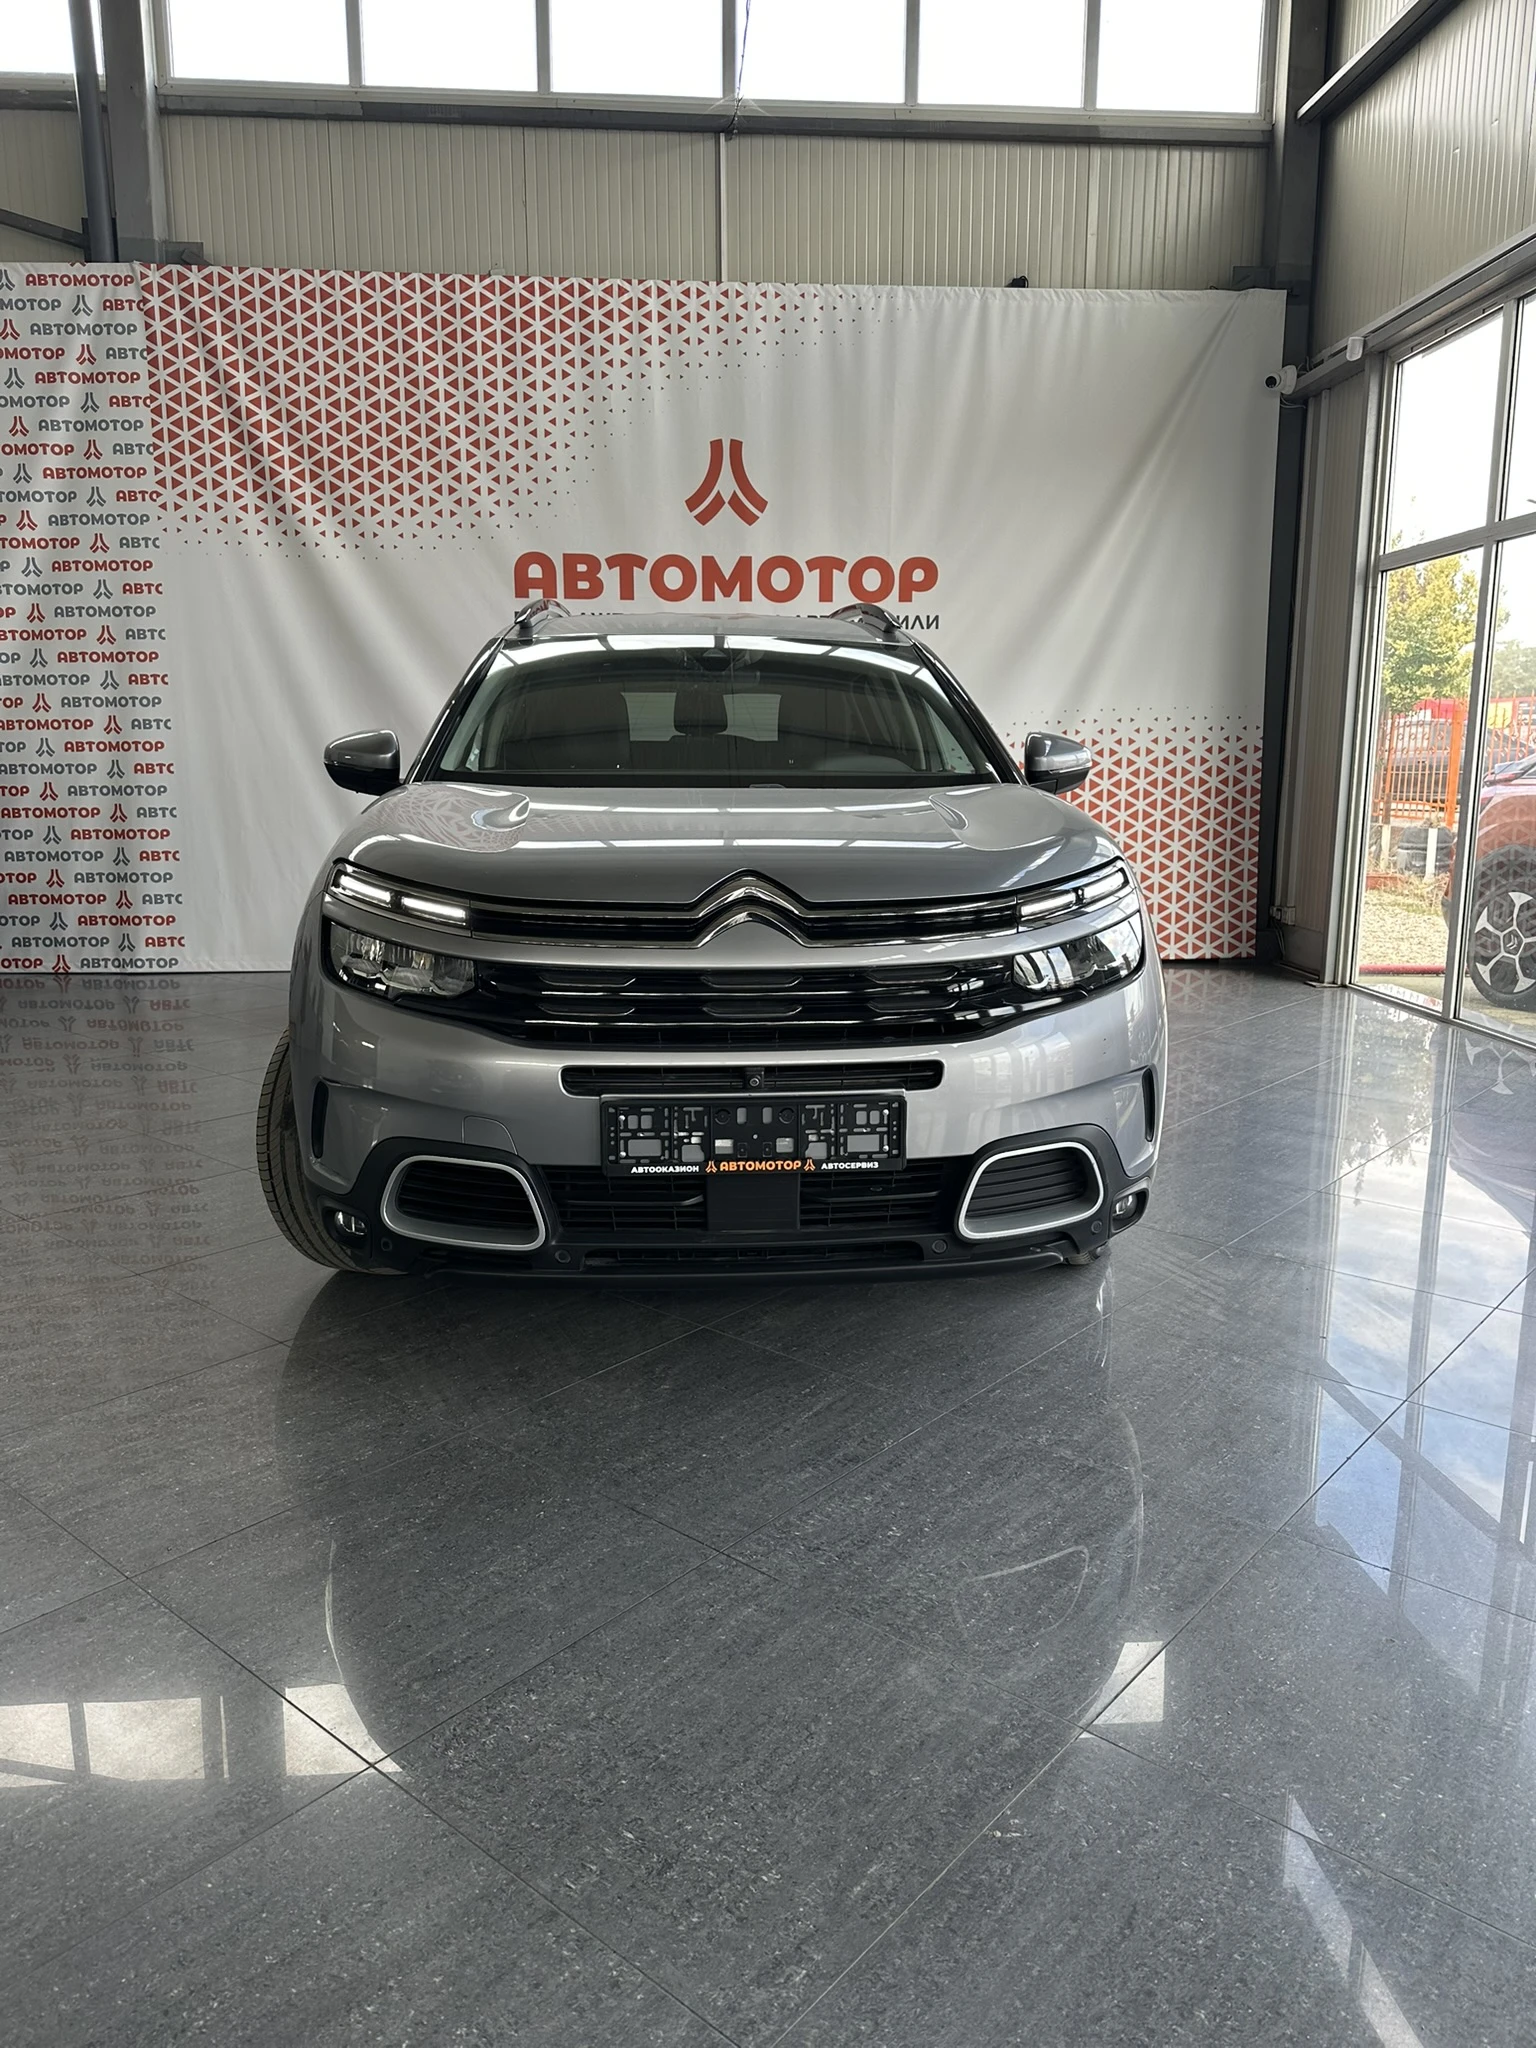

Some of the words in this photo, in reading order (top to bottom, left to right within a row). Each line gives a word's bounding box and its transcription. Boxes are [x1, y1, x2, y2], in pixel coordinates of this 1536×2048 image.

[25, 274, 134, 286] АВТОМОТОР
[30, 323, 138, 335] АВТОМОТОР
[35, 372, 140, 384] АВТОМОТОР
[38, 419, 144, 432] АВТОМОТОР
[43, 467, 147, 479] АВТОМОТОР
[48, 514, 150, 526] АВТОМОТОР
[52, 560, 153, 572] АВТОМОТОР
[513, 551, 939, 603] АВТОМОТОР
[0, 583, 83, 595] ТОМОТОР
[54, 606, 156, 618] АВТОМОТОР
[57, 651, 159, 663] АВТОМОТОР
[0, 674, 90, 686] ВТОМОТОР
[61, 696, 162, 708] АВТОМОТОР
[64, 741, 165, 752] АВТОМОТОР
[0, 763, 97, 774] АВТОМОТОР
[68, 785, 167, 796] АВТОМОТОР
[1, 807, 100, 819] АВТОМОТОР
[71, 829, 170, 840] АВТОМОТОР
[4, 851, 103, 862] АВТОМОТОР
[74, 872, 173, 883] АВТОМОТОР
[8, 894, 107, 905] АВТОМОТОР
[78, 915, 176, 926] АВТОМОТОР
[12, 937, 109, 948] АВТОМОТОР
[80, 958, 179, 969] АВТОМОТОР
[631, 1165, 700, 1174] АВТООКАЗИОН
[719, 1160, 801, 1172] АВТОМОТОР
[821, 1162, 879, 1170] АВТОСЕРВИЗ
